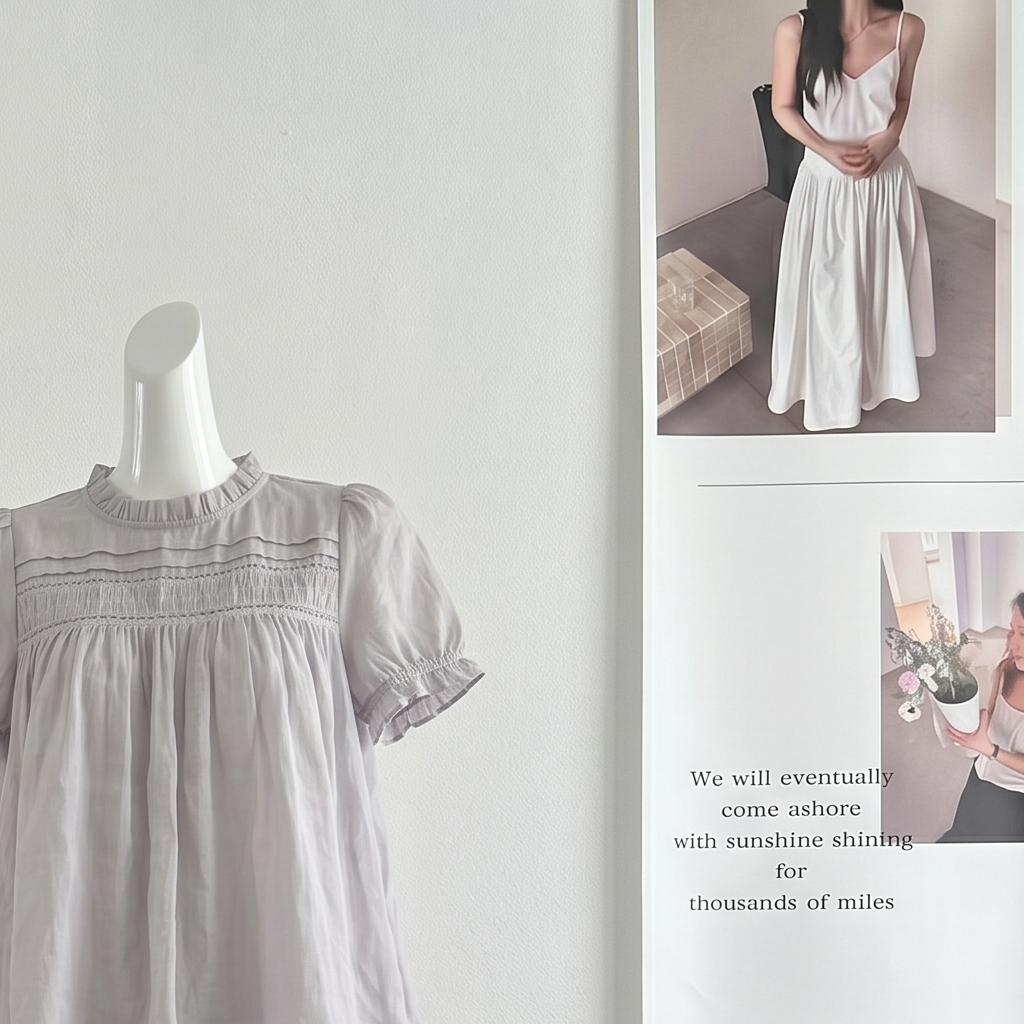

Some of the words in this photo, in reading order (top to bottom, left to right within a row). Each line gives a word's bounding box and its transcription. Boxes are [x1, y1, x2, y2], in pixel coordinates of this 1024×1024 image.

[689, 770, 724, 788] We
[731, 769, 772, 787] will
[779, 767, 894, 788] eventually
[720, 804, 780, 819] come
[787, 799, 862, 818] ashore
[673, 832, 718, 850] with
[725, 831, 824, 850] sunshine
[831, 830, 914, 851] shining
[775, 861, 808, 880] for
[689, 893, 798, 912] thousands
[806, 892, 832, 911] of
[837, 892, 895, 911] miles
